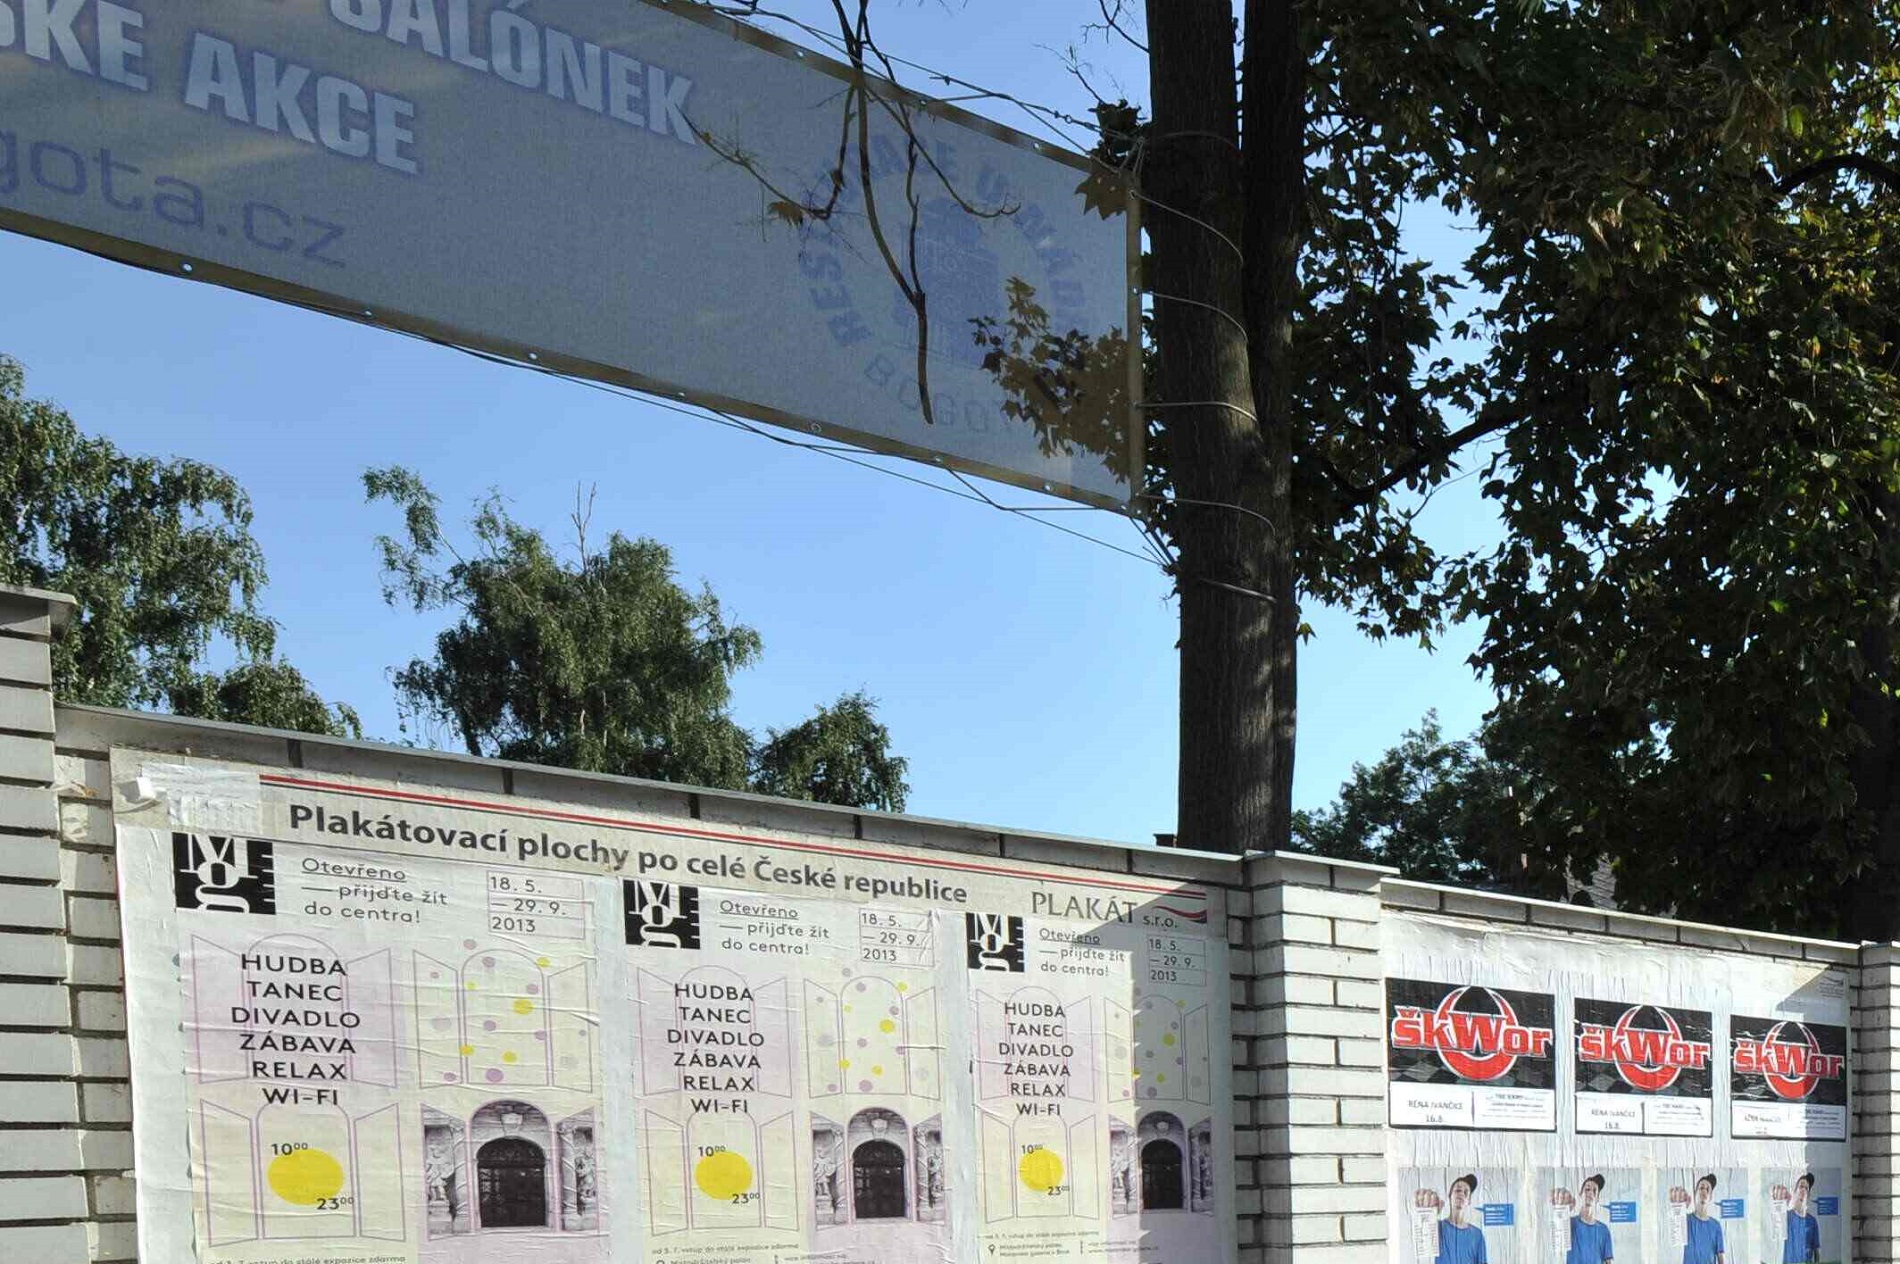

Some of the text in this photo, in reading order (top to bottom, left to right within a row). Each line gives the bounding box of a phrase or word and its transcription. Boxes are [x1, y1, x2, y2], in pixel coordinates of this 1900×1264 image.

[185, 32, 418, 175] AKCE
[290, 804, 968, 903] Plakátovací plochy po celé České republice
[302, 857, 407, 881] Otevřeno
[490, 876, 542, 894] 18. 5.
[338, 884, 448, 905] přijďte žít
[304, 902, 421, 924] do centra!
[514, 898, 543, 914] 29.
[720, 900, 798, 919] Otevřeno
[1031, 891, 1178, 929] PLAKÁT s.r.o.
[492, 916, 536, 933] 2013
[862, 913, 883, 926] 18.
[747, 922, 804, 937] přijďte
[880, 932, 901, 944] 29.
[1039, 927, 1101, 944] Otevřeno
[721, 938, 809, 956] do centra!
[863, 948, 897, 962] 2013
[240, 953, 347, 976] HUDBA
[1040, 961, 1109, 977] do centra!
[1150, 969, 1177, 981] 2013
[247, 980, 343, 1002] TANEC
[674, 983, 754, 1002] HUDBA
[231, 1006, 361, 1029] DIVADLO
[678, 1006, 752, 1025] TANEC
[1004, 1002, 1066, 1018] HUDBA
[666, 1029, 765, 1047] DIVADLO
[1007, 1022, 1064, 1038] TANEC
[239, 1028, 357, 1055] ZÁBAVA
[999, 1042, 1074, 1059] DIVADLO
[673, 1048, 761, 1069] ZÁBAVA
[252, 1059, 348, 1081] RELAX
[1003, 1059, 1071, 1078] ZÁBAVA
[682, 1074, 756, 1092] RELAX
[1010, 1082, 1066, 1097] RELAX
[262, 1088, 339, 1106] WI-FI
[690, 1098, 749, 1114] WI-FI
[1016, 1103, 1061, 1117] WI-FI
